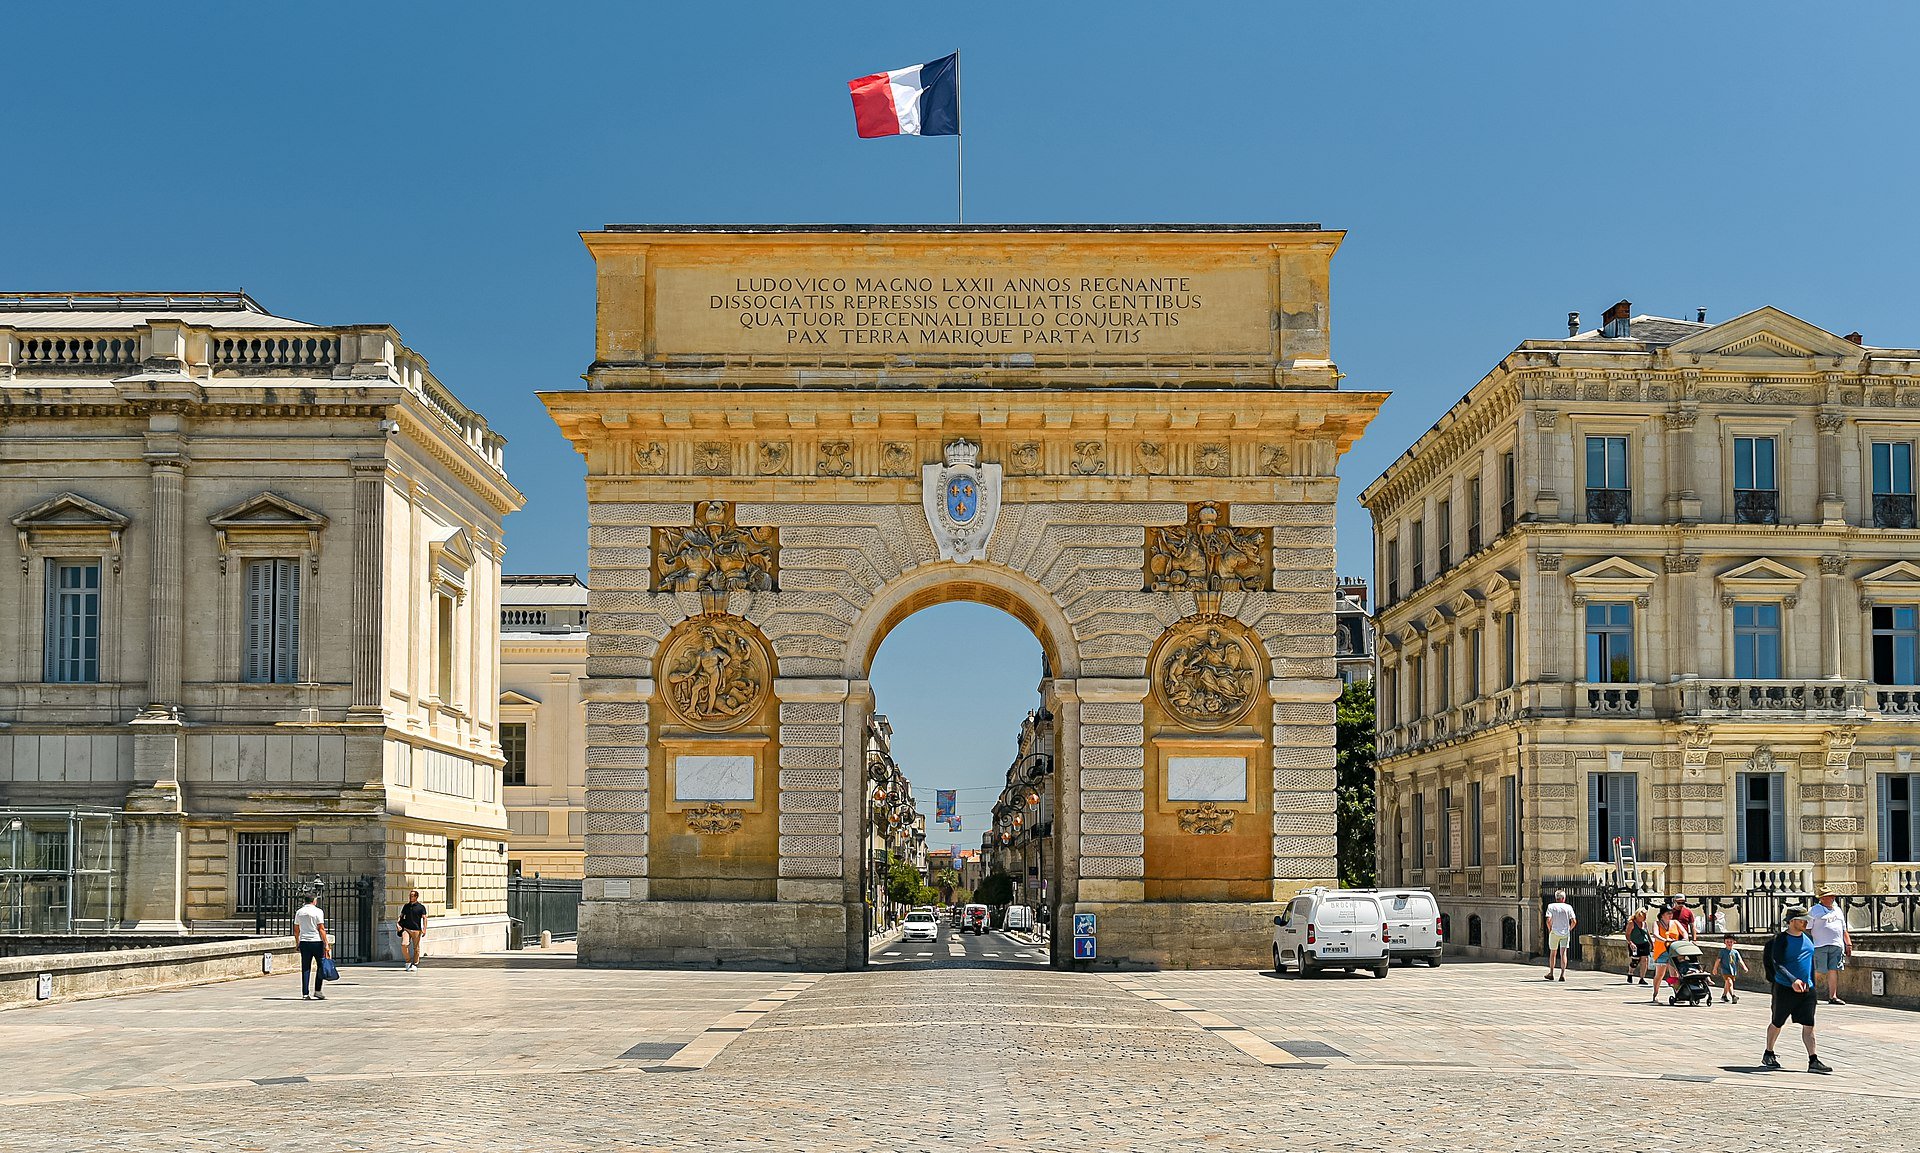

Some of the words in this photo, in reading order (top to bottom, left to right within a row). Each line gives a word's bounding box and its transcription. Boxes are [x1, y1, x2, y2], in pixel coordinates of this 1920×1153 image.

[737, 278, 845, 292] LUDOVICO
[856, 278, 932, 292] MAGNO
[943, 278, 993, 292] LXXII
[1004, 278, 1070, 292] ANNOS
[1081, 278, 1190, 292] REGNANTE
[710, 295, 834, 309] DISSOCIATIS
[844, 295, 937, 309] REPRESSIS
[948, 295, 1081, 309] CONCILIATIS
[1093, 295, 1201, 309] GENTIBUS
[740, 312, 845, 328] QUATUOR
[856, 312, 972, 326] DECENNALI
[982, 312, 1044, 326] BELLO
[1055, 312, 1178, 328] CONJURATIS
[788, 330, 828, 344] PAX
[839, 330, 909, 344] TERRA
[920, 330, 1012, 347] MARIQUE
[1024, 330, 1095, 344] PARTA
[1106, 330, 1141, 344] 1715
